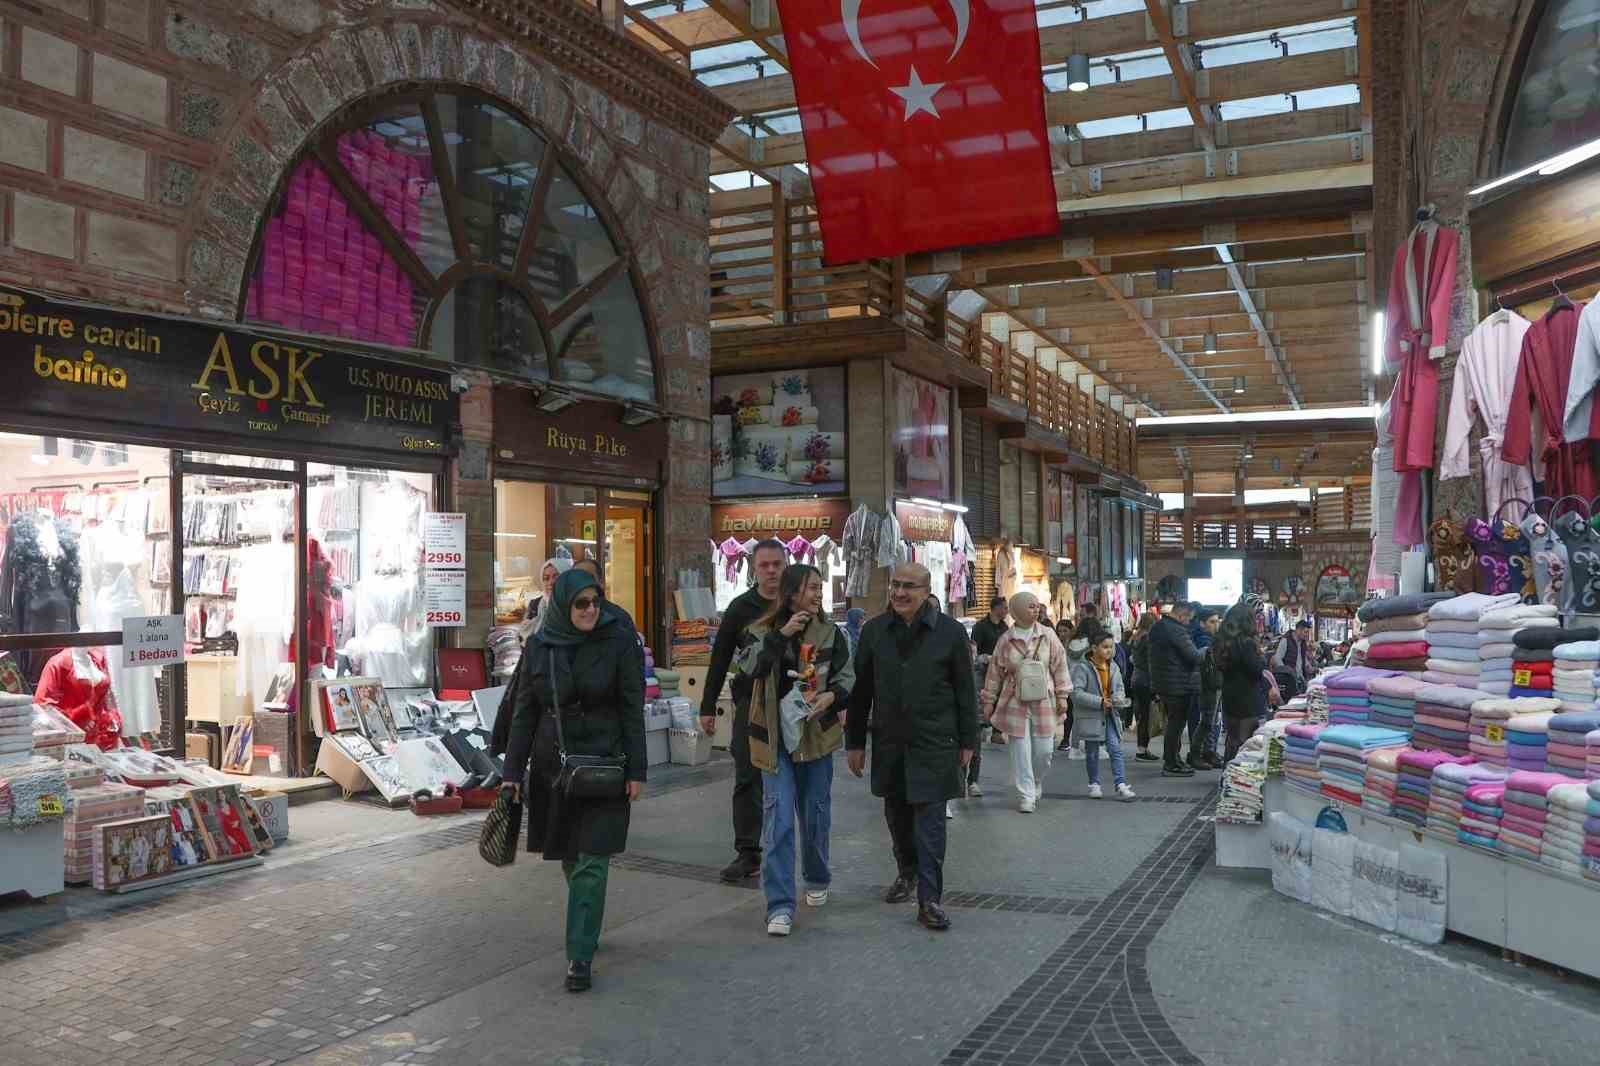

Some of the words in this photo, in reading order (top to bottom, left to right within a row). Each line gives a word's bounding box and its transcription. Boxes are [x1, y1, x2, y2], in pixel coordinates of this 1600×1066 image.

[83, 323, 161, 354] cardin
[33, 344, 128, 389] barina
[376, 371, 412, 395] POLO
[199, 392, 240, 415] Çeyiz
[547, 427, 586, 456] Rüya
[595, 434, 626, 457] Pike
[427, 552, 462, 563] 2950
[427, 611, 462, 622] 2550
[139, 648, 178, 661] Bedava
